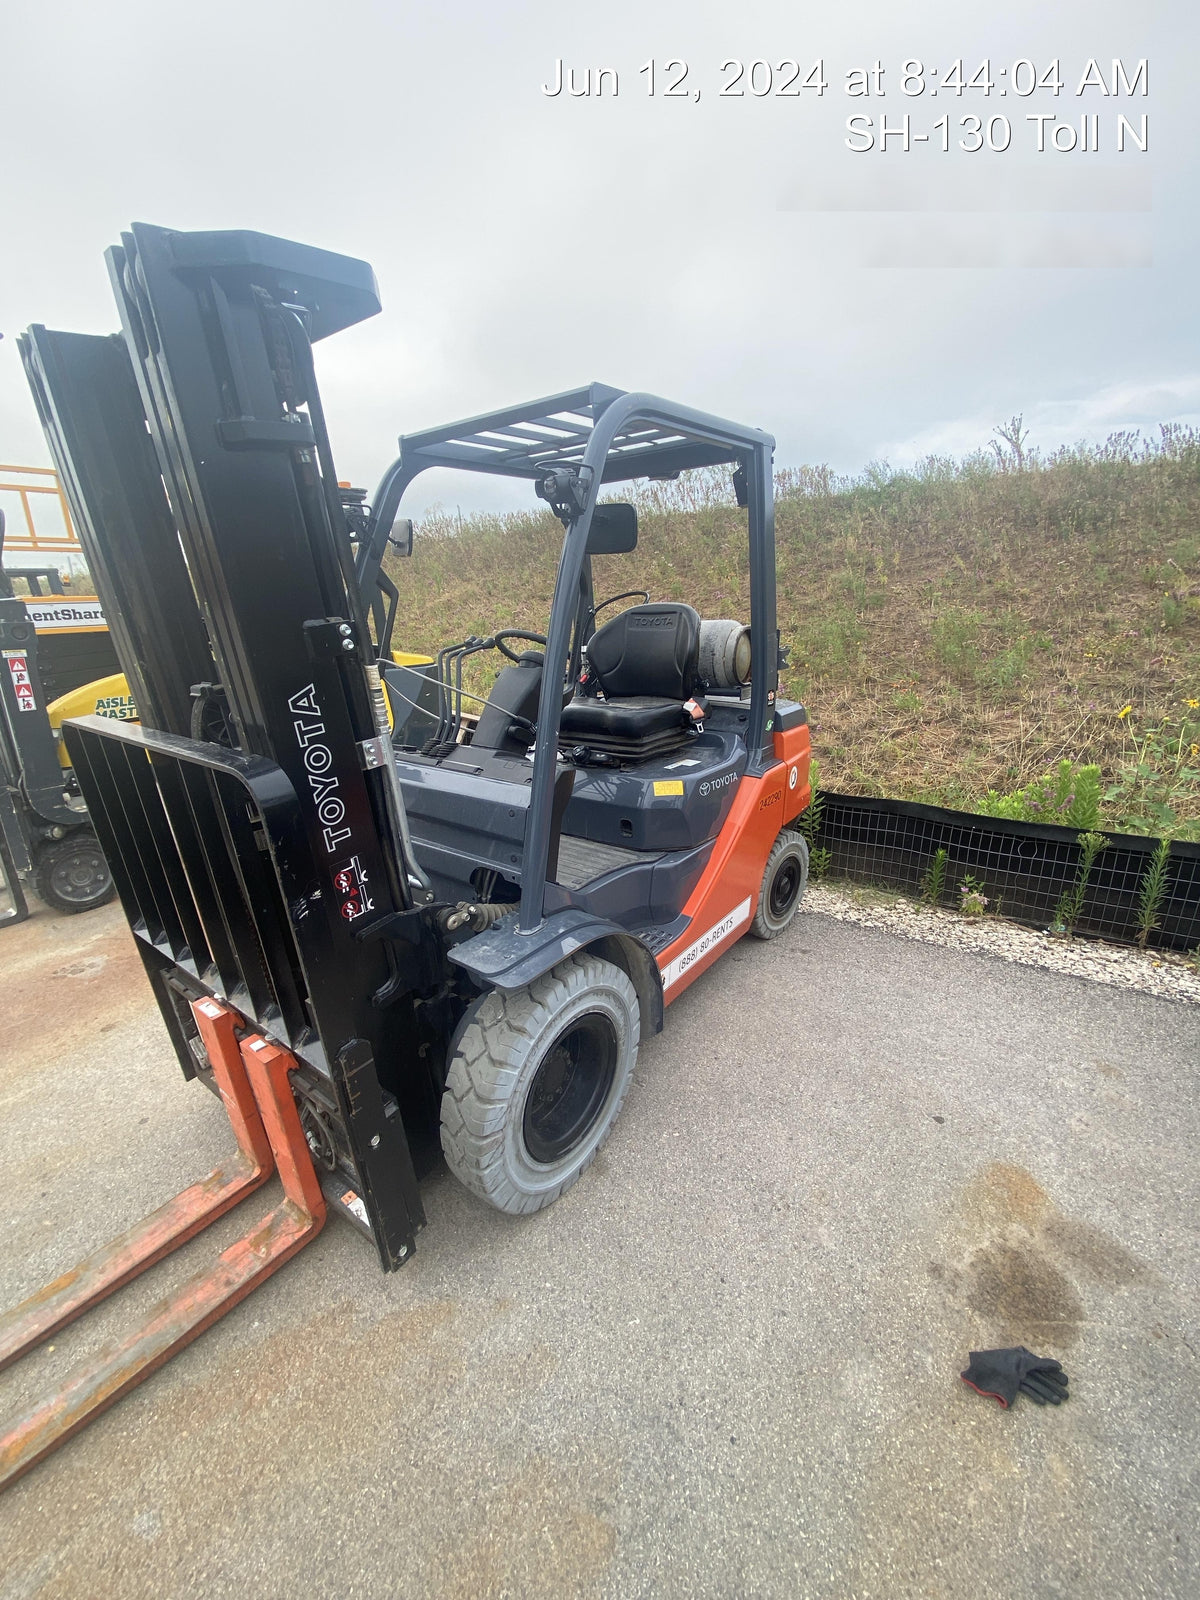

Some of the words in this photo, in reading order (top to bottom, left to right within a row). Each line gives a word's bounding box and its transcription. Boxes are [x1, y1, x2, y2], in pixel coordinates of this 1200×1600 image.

[634, 616, 673, 626] TOYOTA
[288, 683, 352, 853] TOYOTA
[711, 772, 738, 790] TOYOTA
[678, 947, 698, 973] (888)
[699, 916, 734, 953] 80-RENTS
